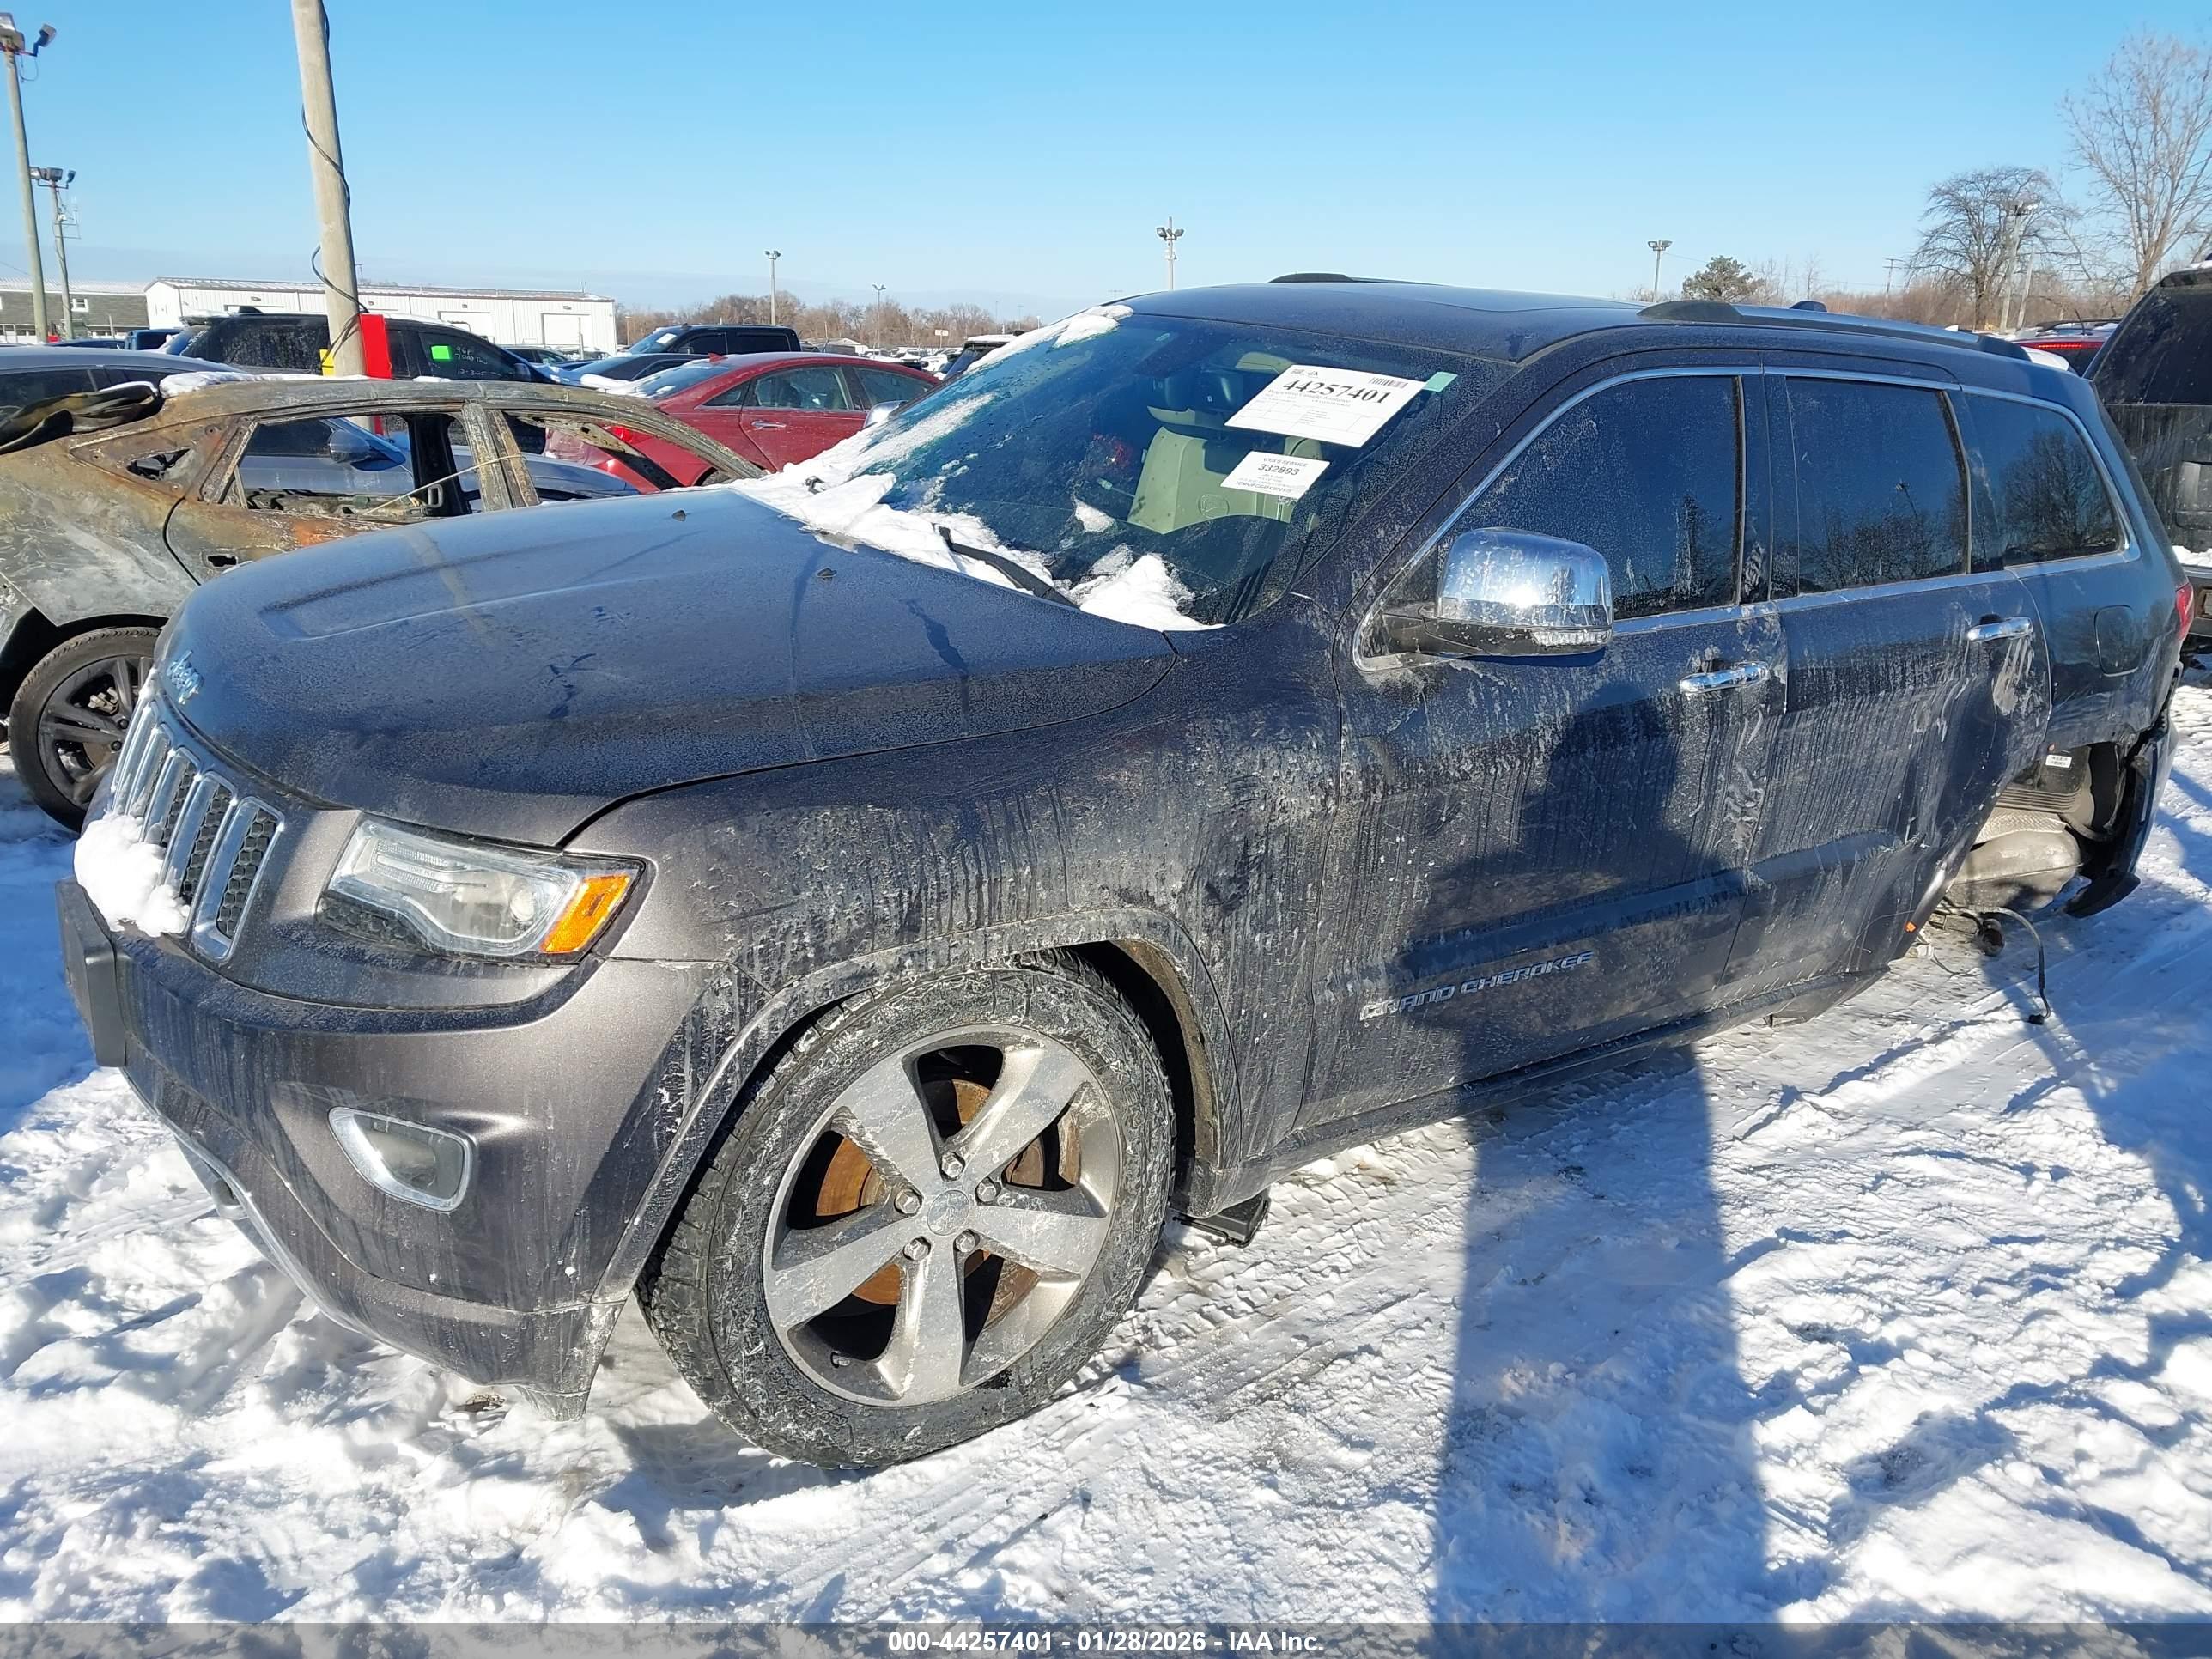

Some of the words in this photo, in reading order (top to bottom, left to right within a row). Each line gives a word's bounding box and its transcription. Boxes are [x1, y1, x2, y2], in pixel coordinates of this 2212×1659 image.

[1282, 379, 1391, 404] 44257401
[1257, 463, 1300, 476] 332893
[1460, 950, 1595, 994] CHEROKEE
